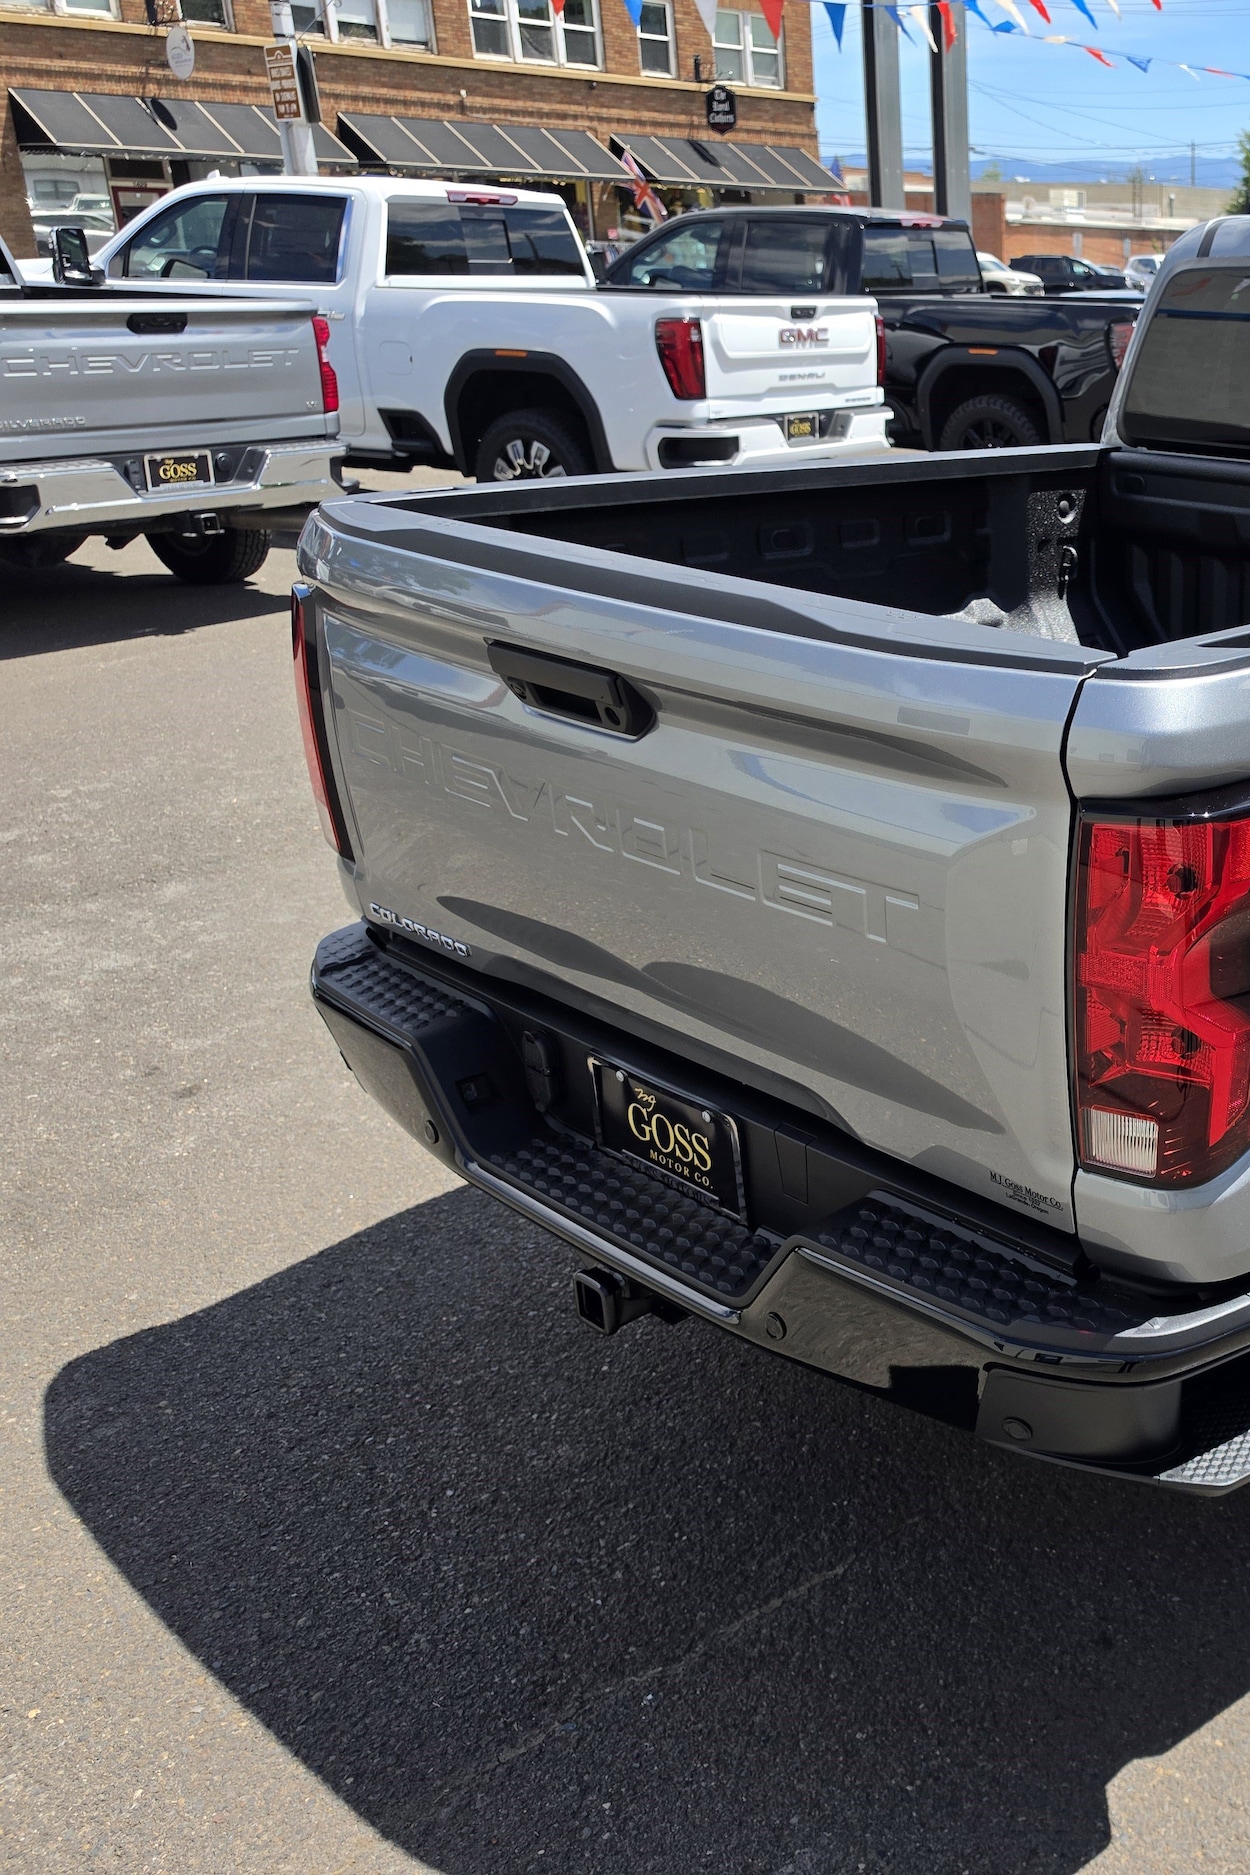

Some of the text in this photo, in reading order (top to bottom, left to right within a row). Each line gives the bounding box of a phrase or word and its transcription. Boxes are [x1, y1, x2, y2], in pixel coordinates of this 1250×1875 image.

[779, 328, 829, 342] GMC
[1, 349, 299, 377] CHEVROLET
[159, 462, 197, 480] GOSS
[347, 710, 920, 943] CHEVROLET
[369, 902, 472, 957] COLORADO
[628, 1102, 713, 1172] GOSS
[649, 1149, 691, 1178] MOTOR
[694, 1171, 714, 1190] CO.
[1004, 1178, 1023, 1193] Goss
[1024, 1185, 1049, 1203] Motor
[1049, 1197, 1064, 1212] Co.
